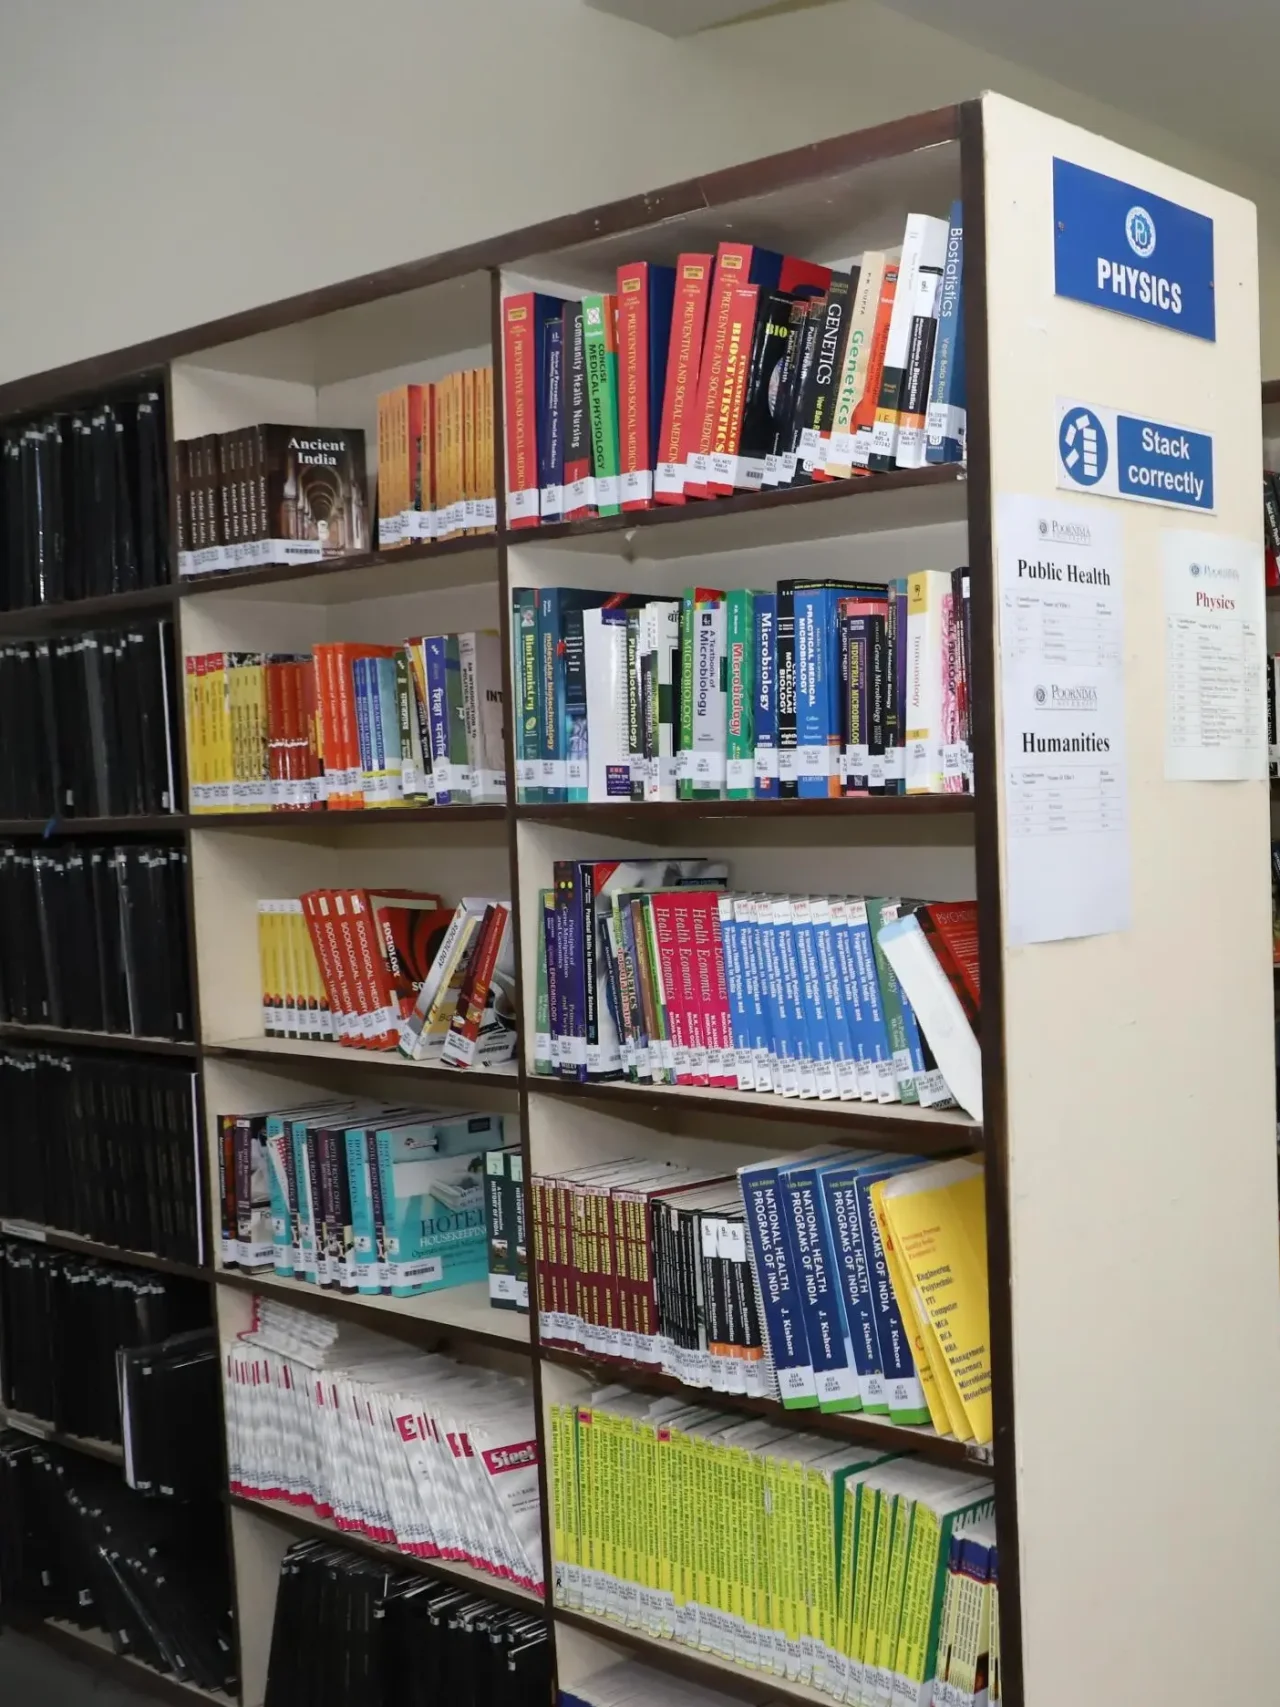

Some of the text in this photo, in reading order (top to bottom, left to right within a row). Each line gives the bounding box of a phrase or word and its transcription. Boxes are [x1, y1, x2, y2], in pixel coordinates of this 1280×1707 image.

[942, 227, 962, 318] Biostatistics
[1097, 257, 1182, 314] PHYSICS
[514, 340, 523, 394] PREVENTIVE
[598, 344, 607, 384] CONCISE
[628, 314, 636, 428] PREVENTIVE AND SOCIAL
[673, 302, 694, 420] PREVENTIVE AND SOCIAL
[706, 290, 731, 410] PREVENTIVE AND SOCIAL
[817, 303, 842, 385] GENETICS
[572, 314, 584, 448] Community Health Nursing
[714, 322, 742, 453] BIOSTATISTICS
[731, 354, 746, 434] FUNDAMENTALS
[838, 330, 864, 426] Genetics
[908, 368, 922, 410] Biostatistics
[516, 416, 524, 449] SOCIAL
[588, 344, 604, 470] MEDICAL PHYSIOLOGY
[288, 437, 346, 452] Ancient
[298, 452, 337, 466] India
[1142, 427, 1190, 460] Stack
[1128, 465, 1203, 501] correctly
[1273, 528, 1280, 546] Physics
[1018, 559, 1110, 586] Public Health
[1196, 592, 1236, 612] Physics
[525, 634, 536, 710] Biochemistry
[546, 633, 554, 680] molecular
[698, 630, 708, 716] Microbiology
[760, 612, 772, 711] Microbiology
[798, 618, 807, 694] MICROBIOLOGY
[806, 604, 816, 707] PRACTICAL MEDICAL
[851, 642, 859, 688] INDUSTRIAL
[873, 644, 882, 722] General Microbiology
[912, 635, 921, 708] Immunology
[628, 638, 638, 748] Plant Biotechnology
[683, 639, 692, 730] MICROBIOLOGY
[731, 643, 744, 736] Microbiology
[1052, 684, 1098, 700] POORNIMA
[1022, 732, 1110, 752] Humanities
[325, 922, 344, 980] SOCIOLOGICAL
[341, 921, 360, 980] SOCIOLOGICAL
[356, 920, 374, 980] SOCIOLOGICAL
[382, 922, 400, 977] SOCIOLOGY
[437, 922, 459, 969] SOCIOLOGY
[656, 908, 676, 1000] Health Economics
[674, 908, 693, 1000] Health Economics
[693, 908, 711, 1002] Health Economics
[549, 967, 557, 1022] EPIDEMIOLOGY
[626, 956, 638, 1010] GENETICS
[420, 1226, 487, 1248] HOUSEKEEPIN
[752, 1190, 780, 1303] PROGRAMS OF INDIA
[764, 1188, 790, 1291] NATIONAL HEALTH
[790, 1192, 818, 1306] PROGRAMS OF INDIA
[802, 1190, 828, 1293] NATIONAL HEALTH
[833, 1192, 860, 1306] PROGRAMS OF INDIA
[844, 1190, 868, 1294] NATIONAL HEALTH
[876, 1261, 890, 1312] OF INDIA
[916, 1264, 951, 1282] Engineering
[921, 1276, 954, 1294] Polytechnic
[782, 1320, 794, 1356] Kishore
[930, 1302, 958, 1318] Computer
[820, 1322, 832, 1358] Kishore
[862, 1322, 874, 1360] Kishore
[891, 1330, 902, 1368] Kishore
[949, 1346, 985, 1365] Management
[954, 1361, 983, 1378] Pharmacy
[491, 1444, 535, 1470] Steel
